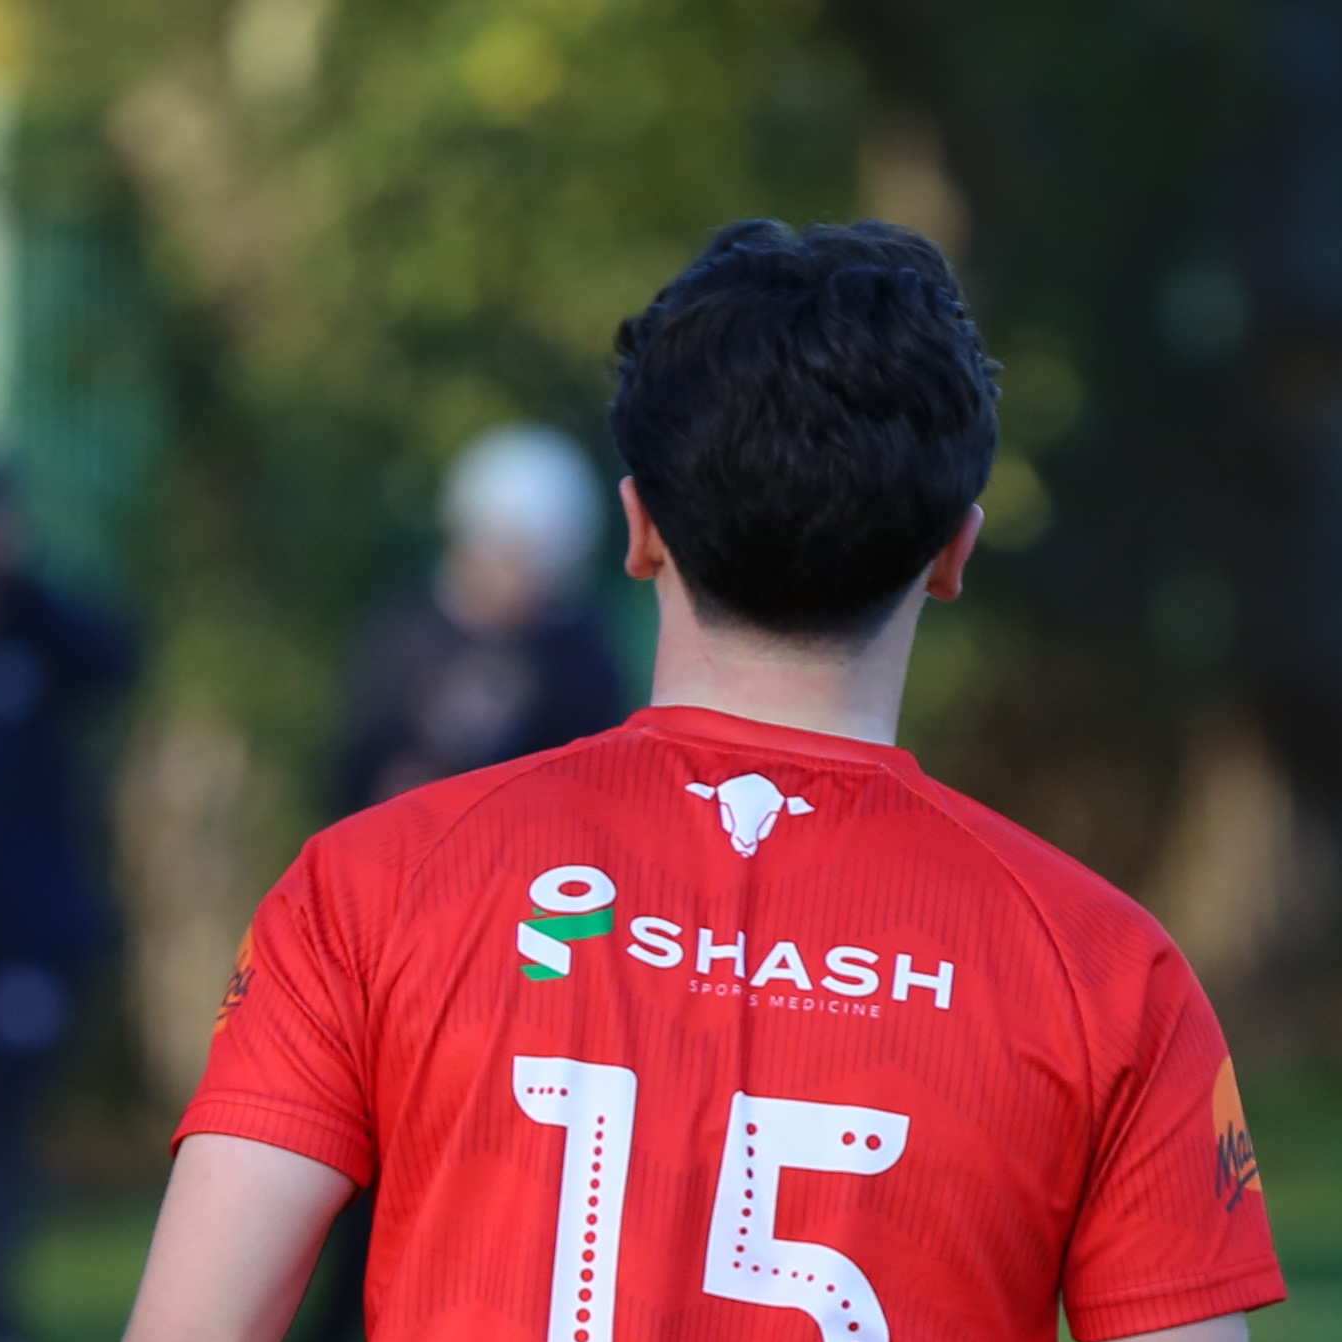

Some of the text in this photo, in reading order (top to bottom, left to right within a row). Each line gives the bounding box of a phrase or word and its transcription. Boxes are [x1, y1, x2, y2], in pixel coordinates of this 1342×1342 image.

[626, 916, 954, 1010] SHASH
[688, 979, 881, 1019] SPORS MEDICINE
